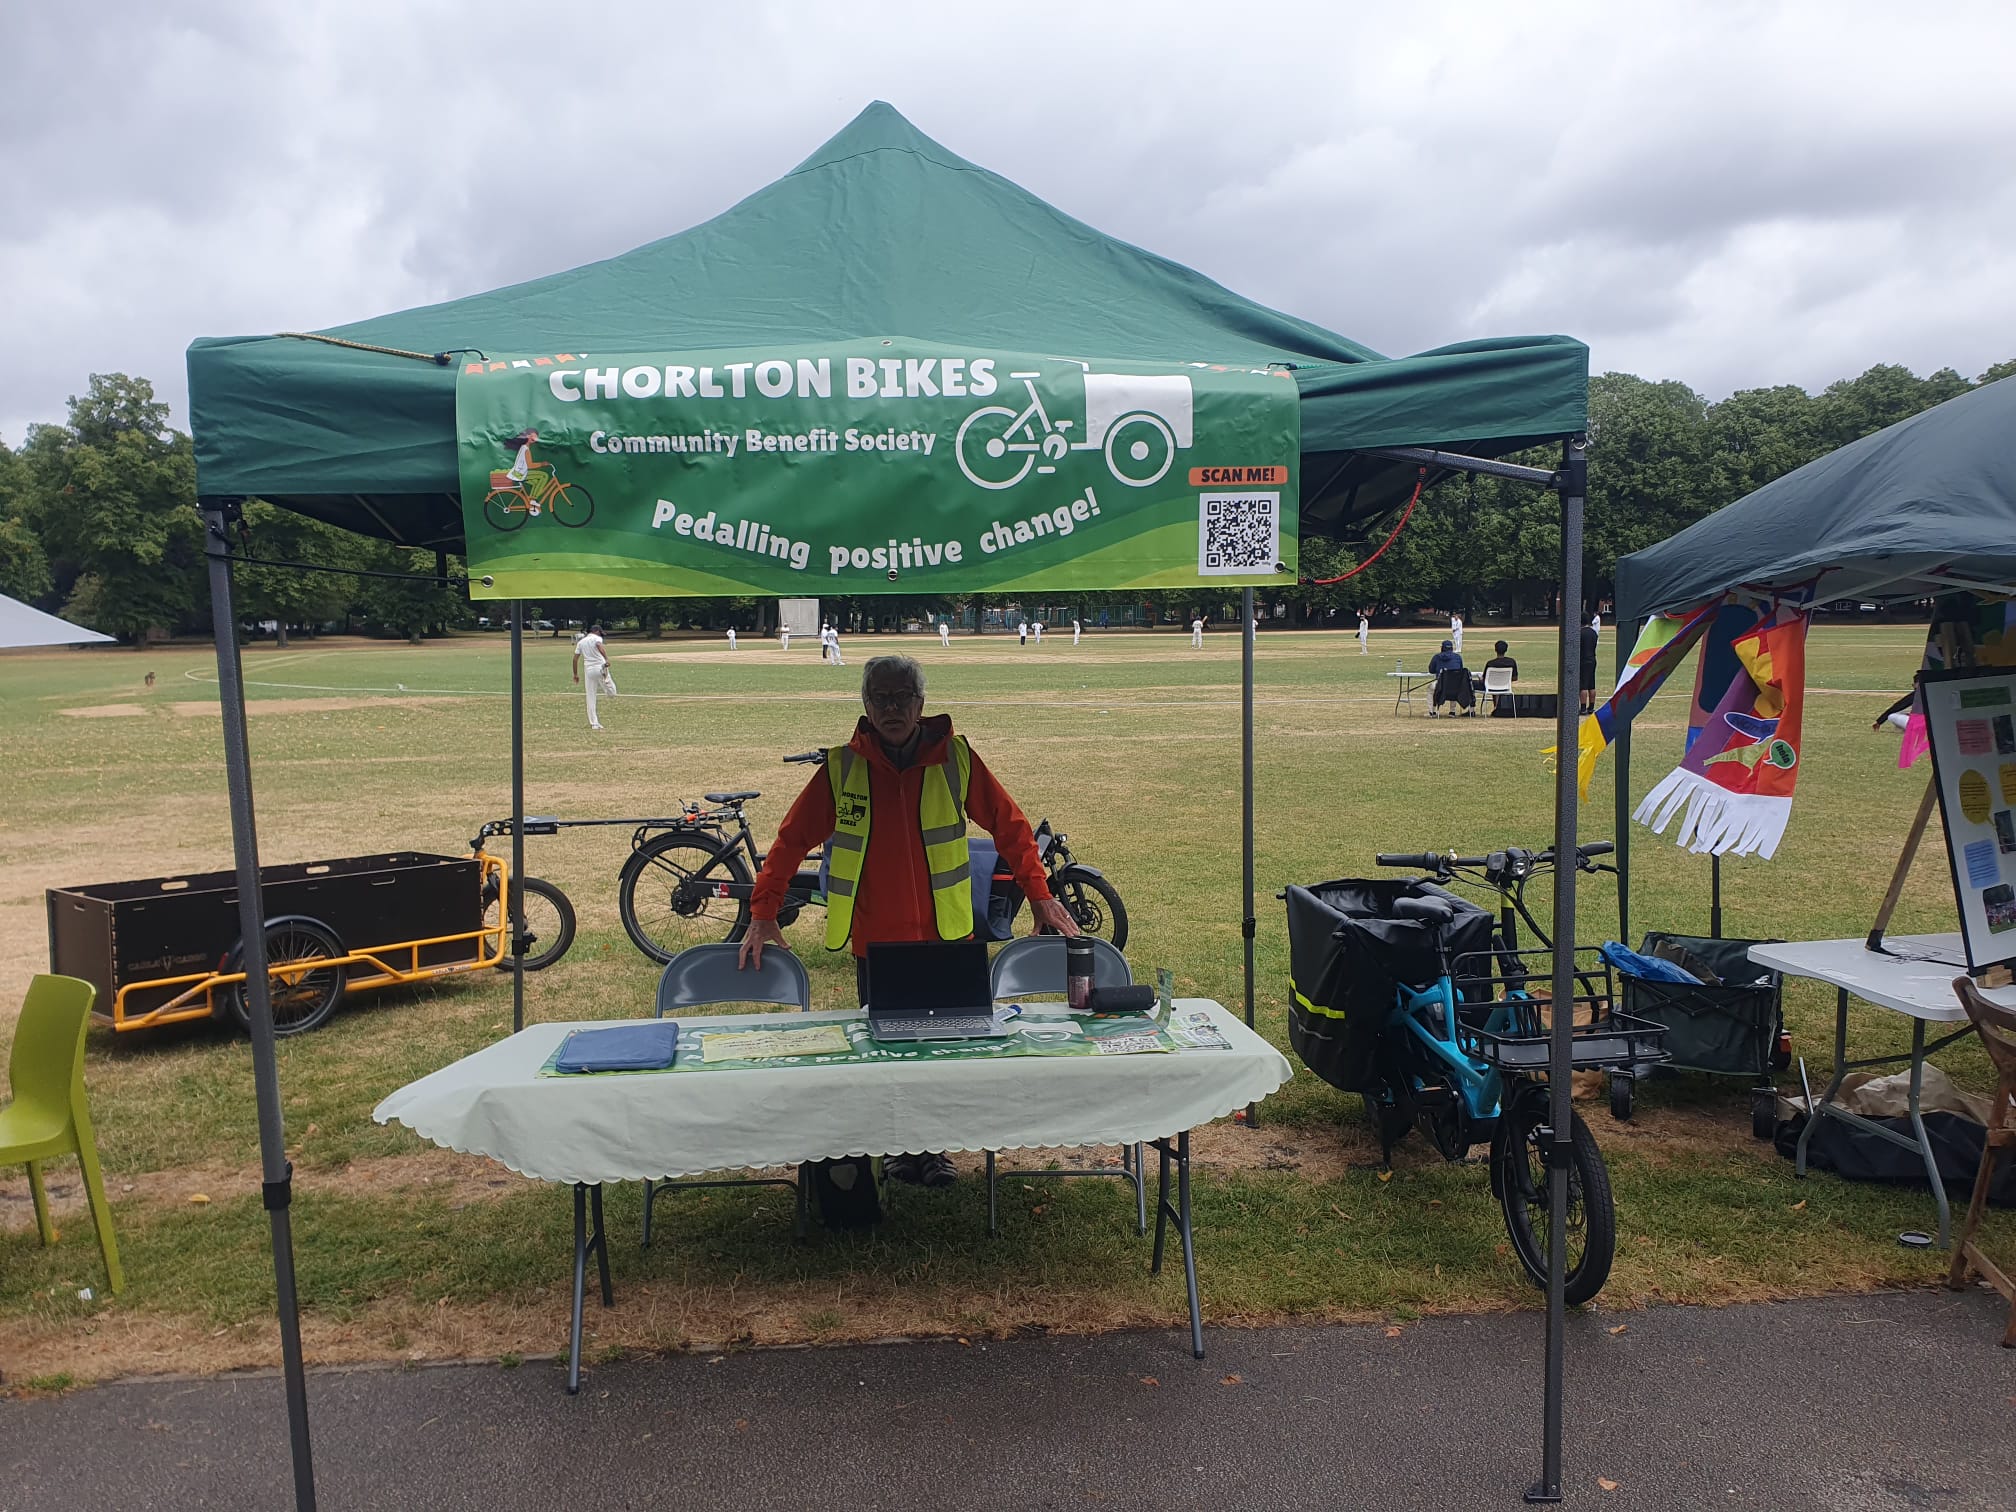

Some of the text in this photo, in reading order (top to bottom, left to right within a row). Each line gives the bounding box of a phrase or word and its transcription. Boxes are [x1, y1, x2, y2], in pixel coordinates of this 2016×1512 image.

[549, 358, 998, 401] CHORLTON BIKES
[590, 427, 936, 458] Community Benefit Society
[1201, 467, 1275, 483] SCAN ME!
[651, 486, 1101, 574] Pedalling positive change!
